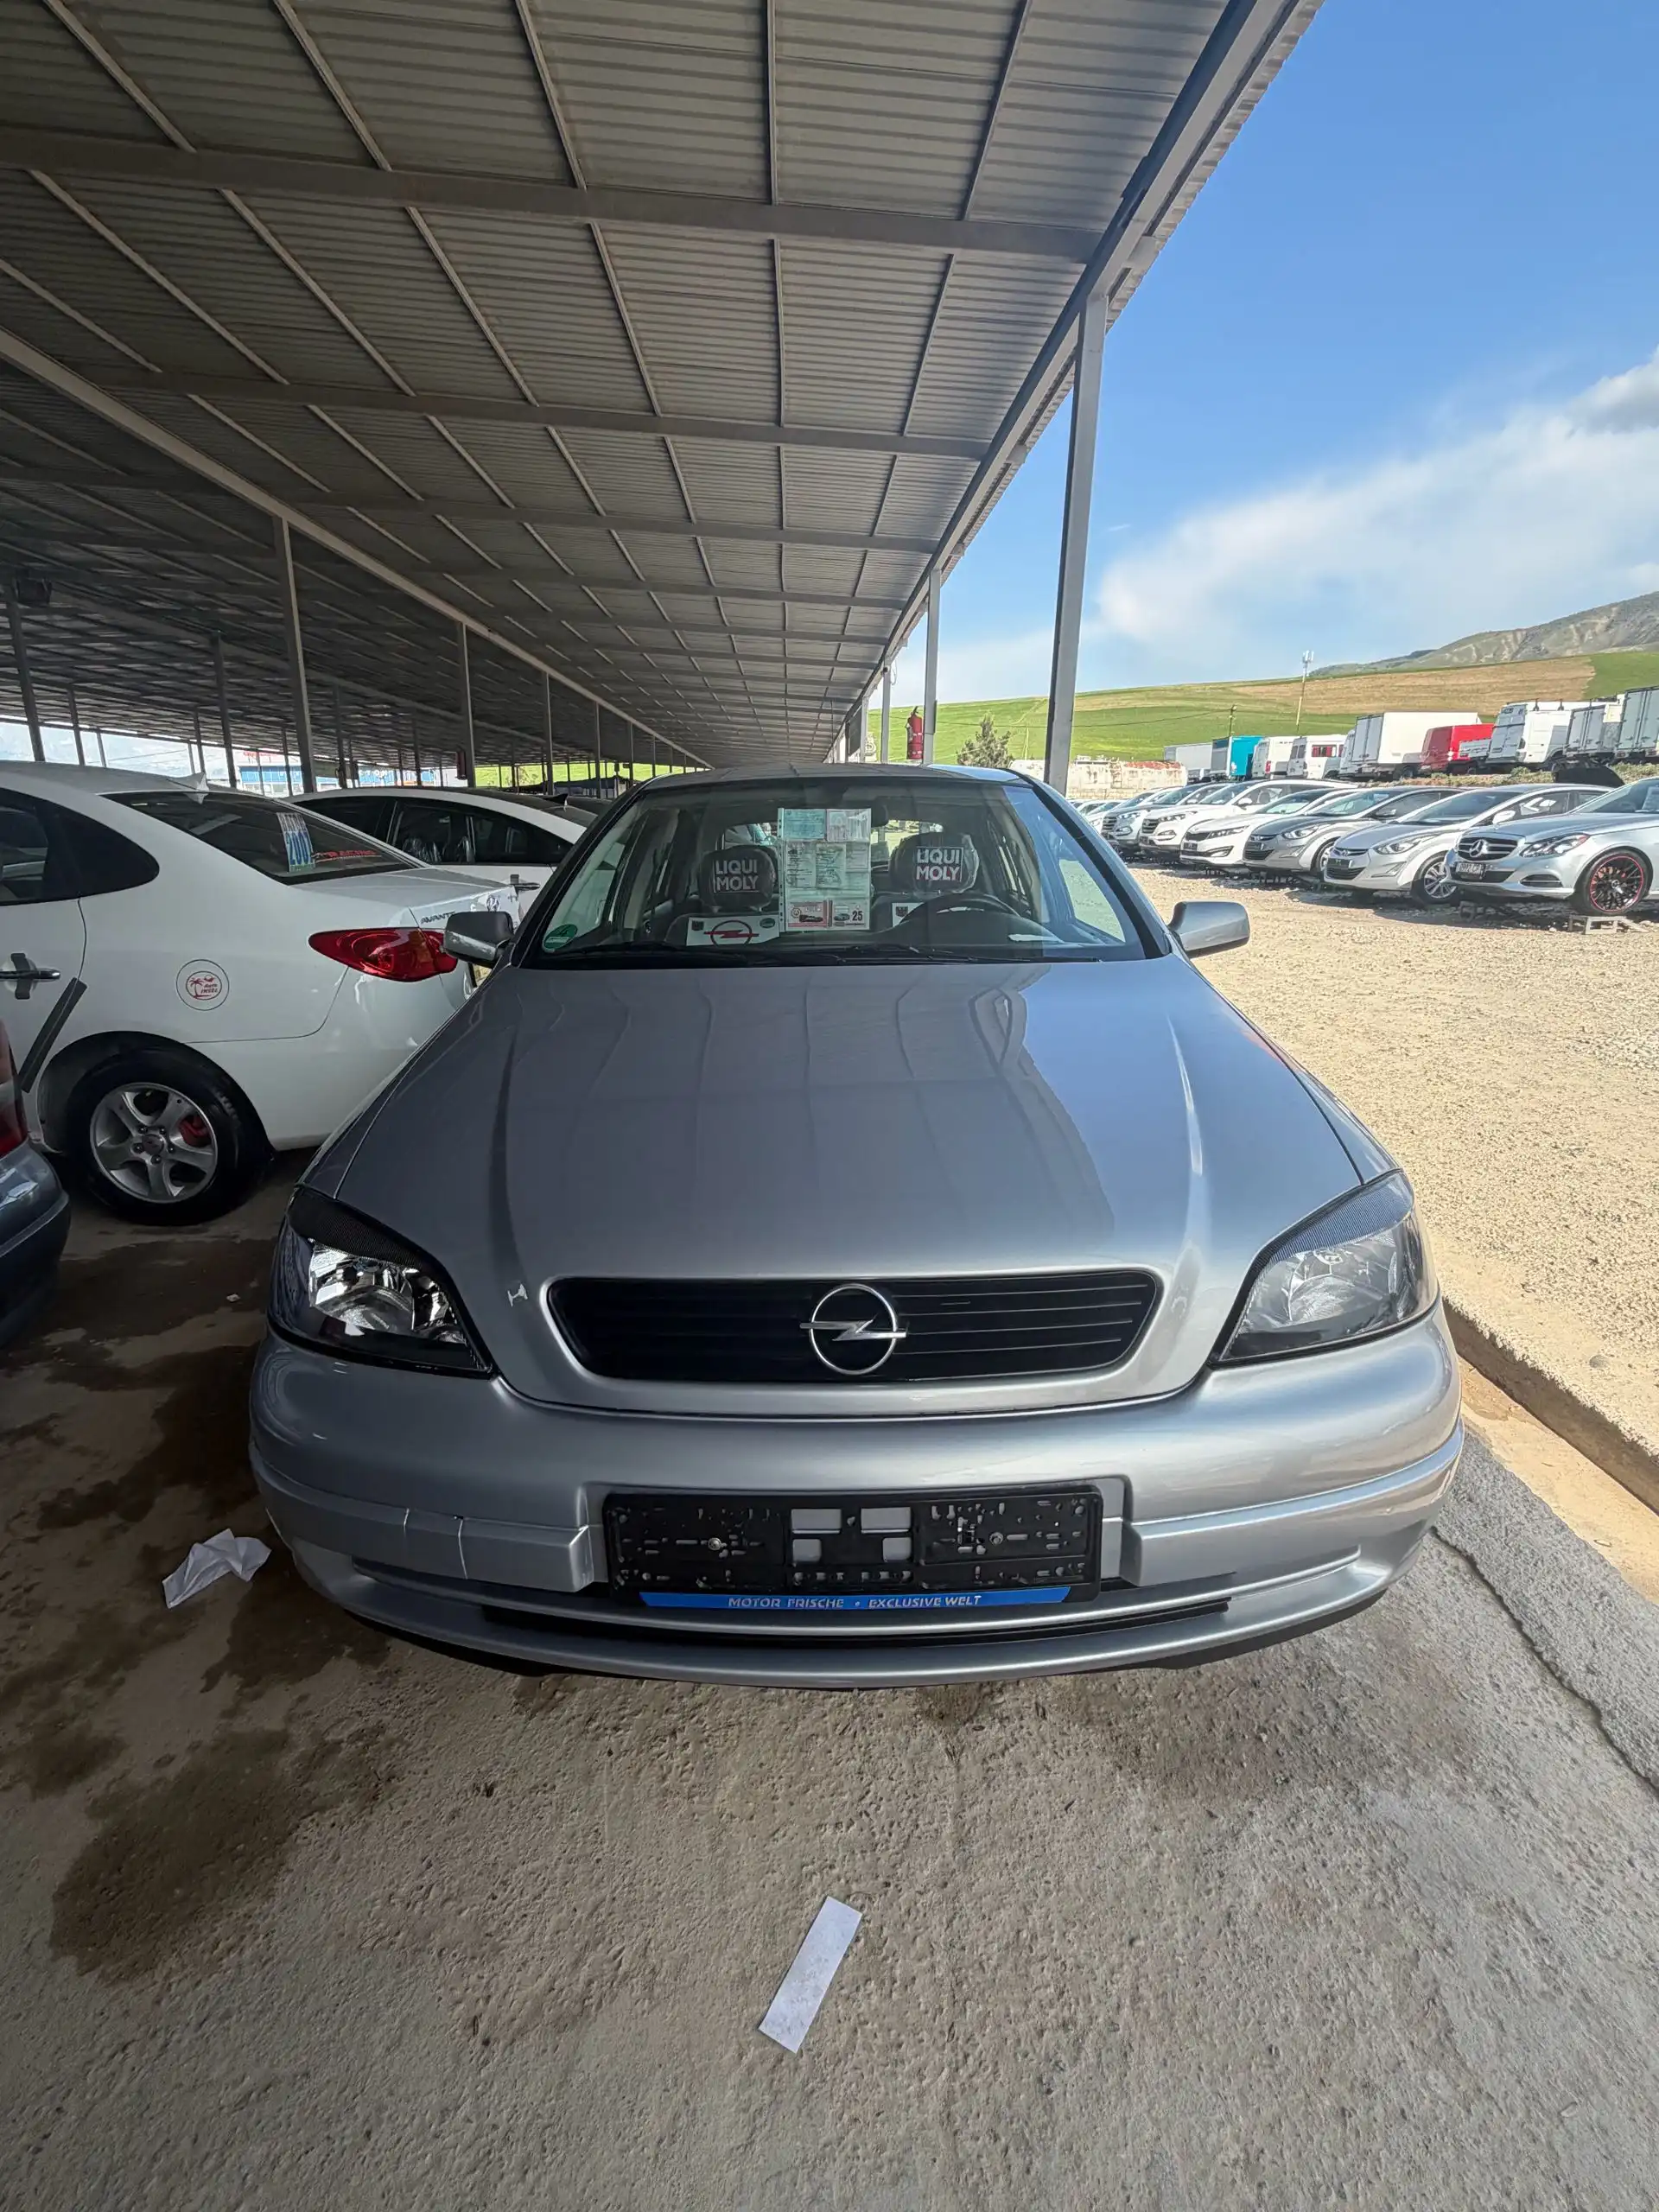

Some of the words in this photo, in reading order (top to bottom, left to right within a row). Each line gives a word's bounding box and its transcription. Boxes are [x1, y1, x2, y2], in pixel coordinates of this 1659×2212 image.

[917, 849, 960, 865] LIQUI
[715, 860, 758, 874] LIQUI
[916, 865, 960, 880] MOLY
[716, 875, 759, 890] MOLY
[421, 911, 455, 924] AVANT
[852, 910, 863, 921] 25
[728, 1598, 781, 1608] MOTOR
[868, 1598, 942, 1608] EXCLUSIVE
[945, 1595, 982, 1606] WELT
